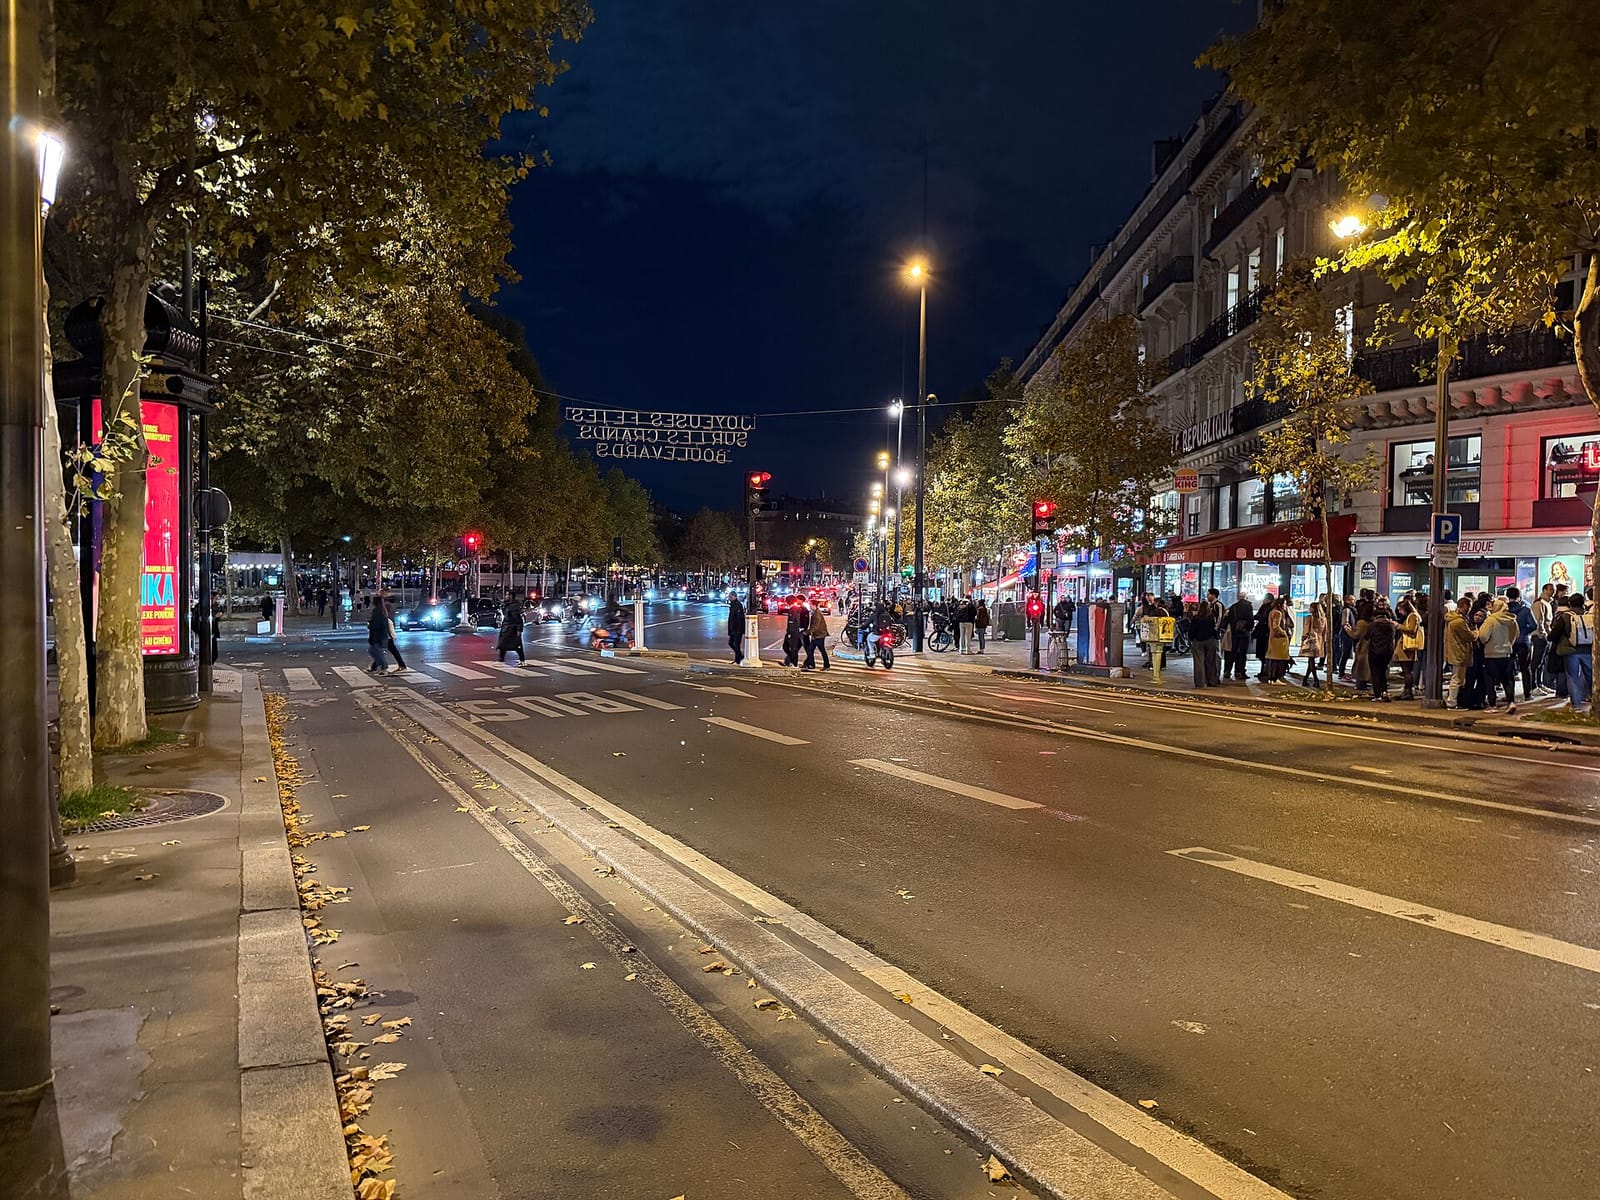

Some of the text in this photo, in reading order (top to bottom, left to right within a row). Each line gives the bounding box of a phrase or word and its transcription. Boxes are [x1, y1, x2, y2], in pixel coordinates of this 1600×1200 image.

[1174, 480, 1197, 489] KING
[1441, 519, 1453, 540] P
[1253, 548, 1299, 558] BURGER
[141, 574, 174, 606] IKA
[460, 691, 643, 722] BUS
